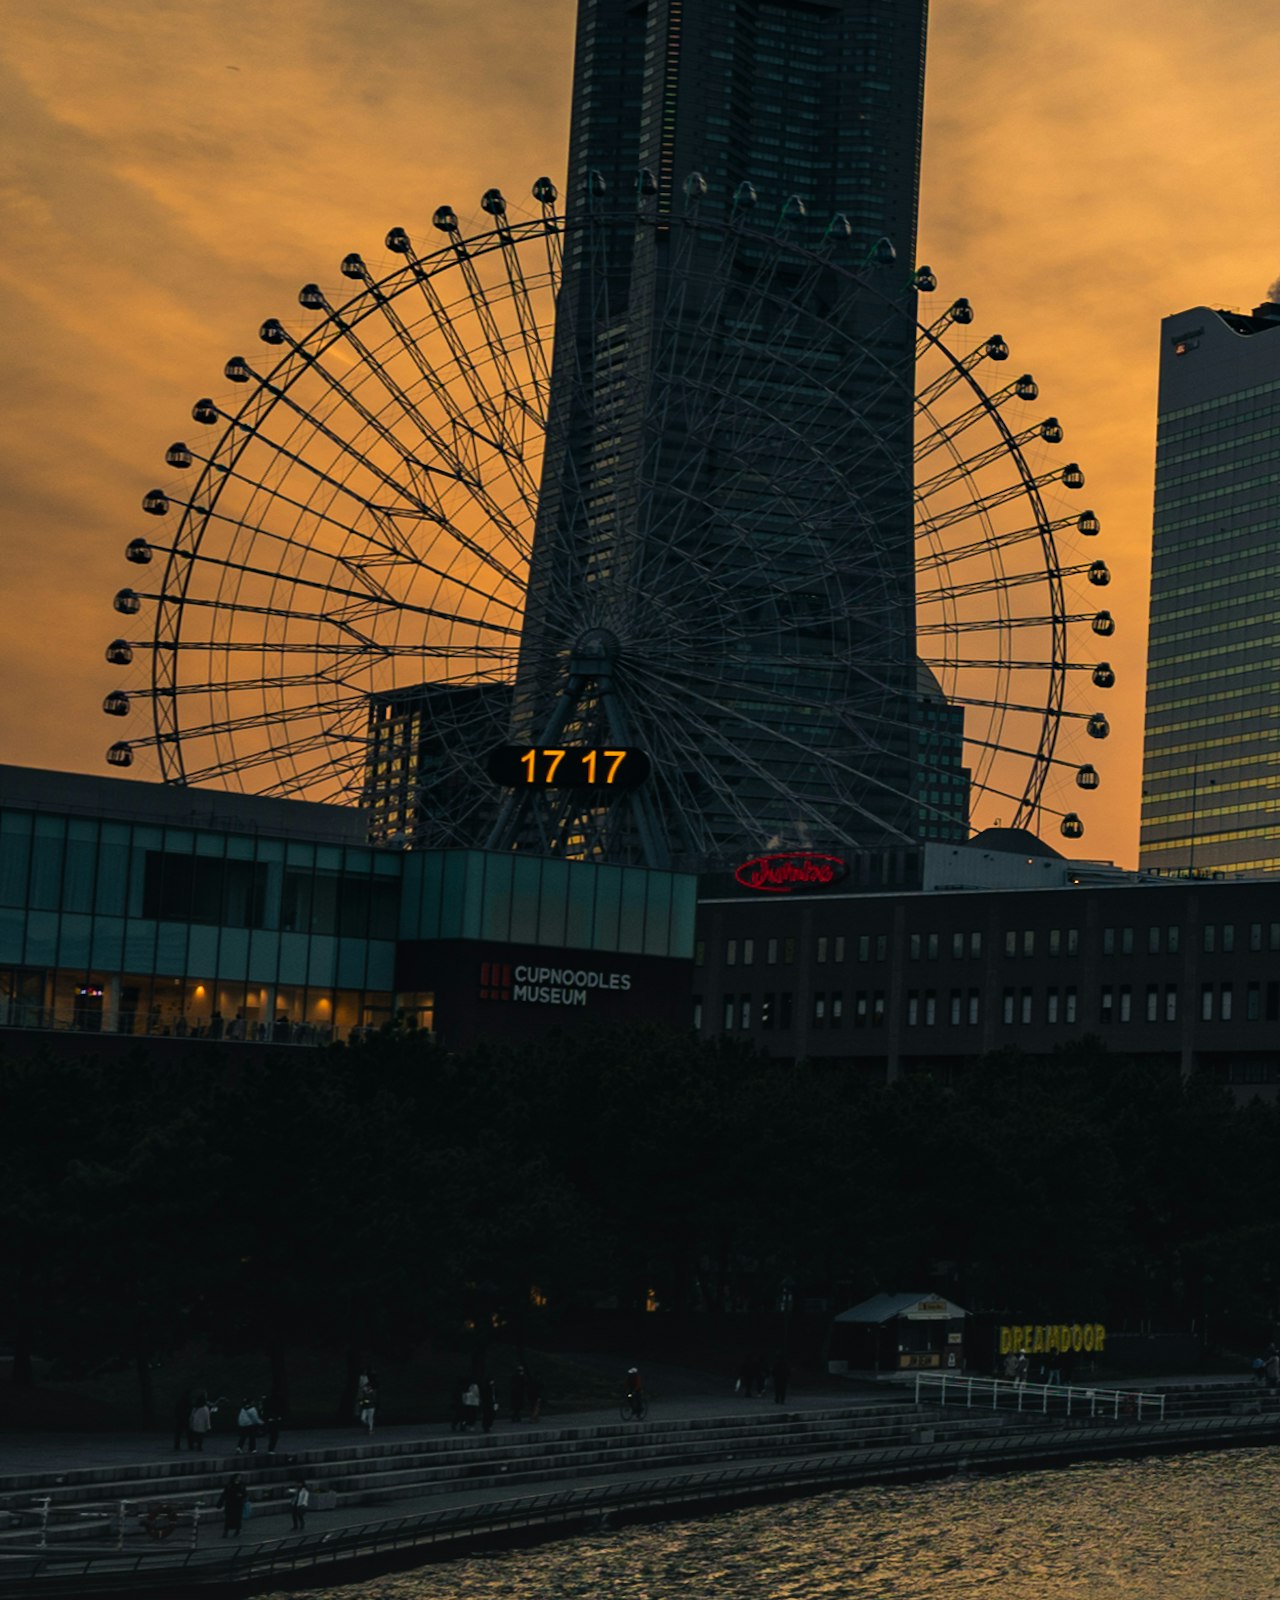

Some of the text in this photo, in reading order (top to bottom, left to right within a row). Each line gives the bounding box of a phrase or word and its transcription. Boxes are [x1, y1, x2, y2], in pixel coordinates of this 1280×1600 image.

[520, 748, 628, 785] 17 17
[514, 964, 632, 991] CUPNOODLES
[512, 984, 587, 1006] MUSEUM
